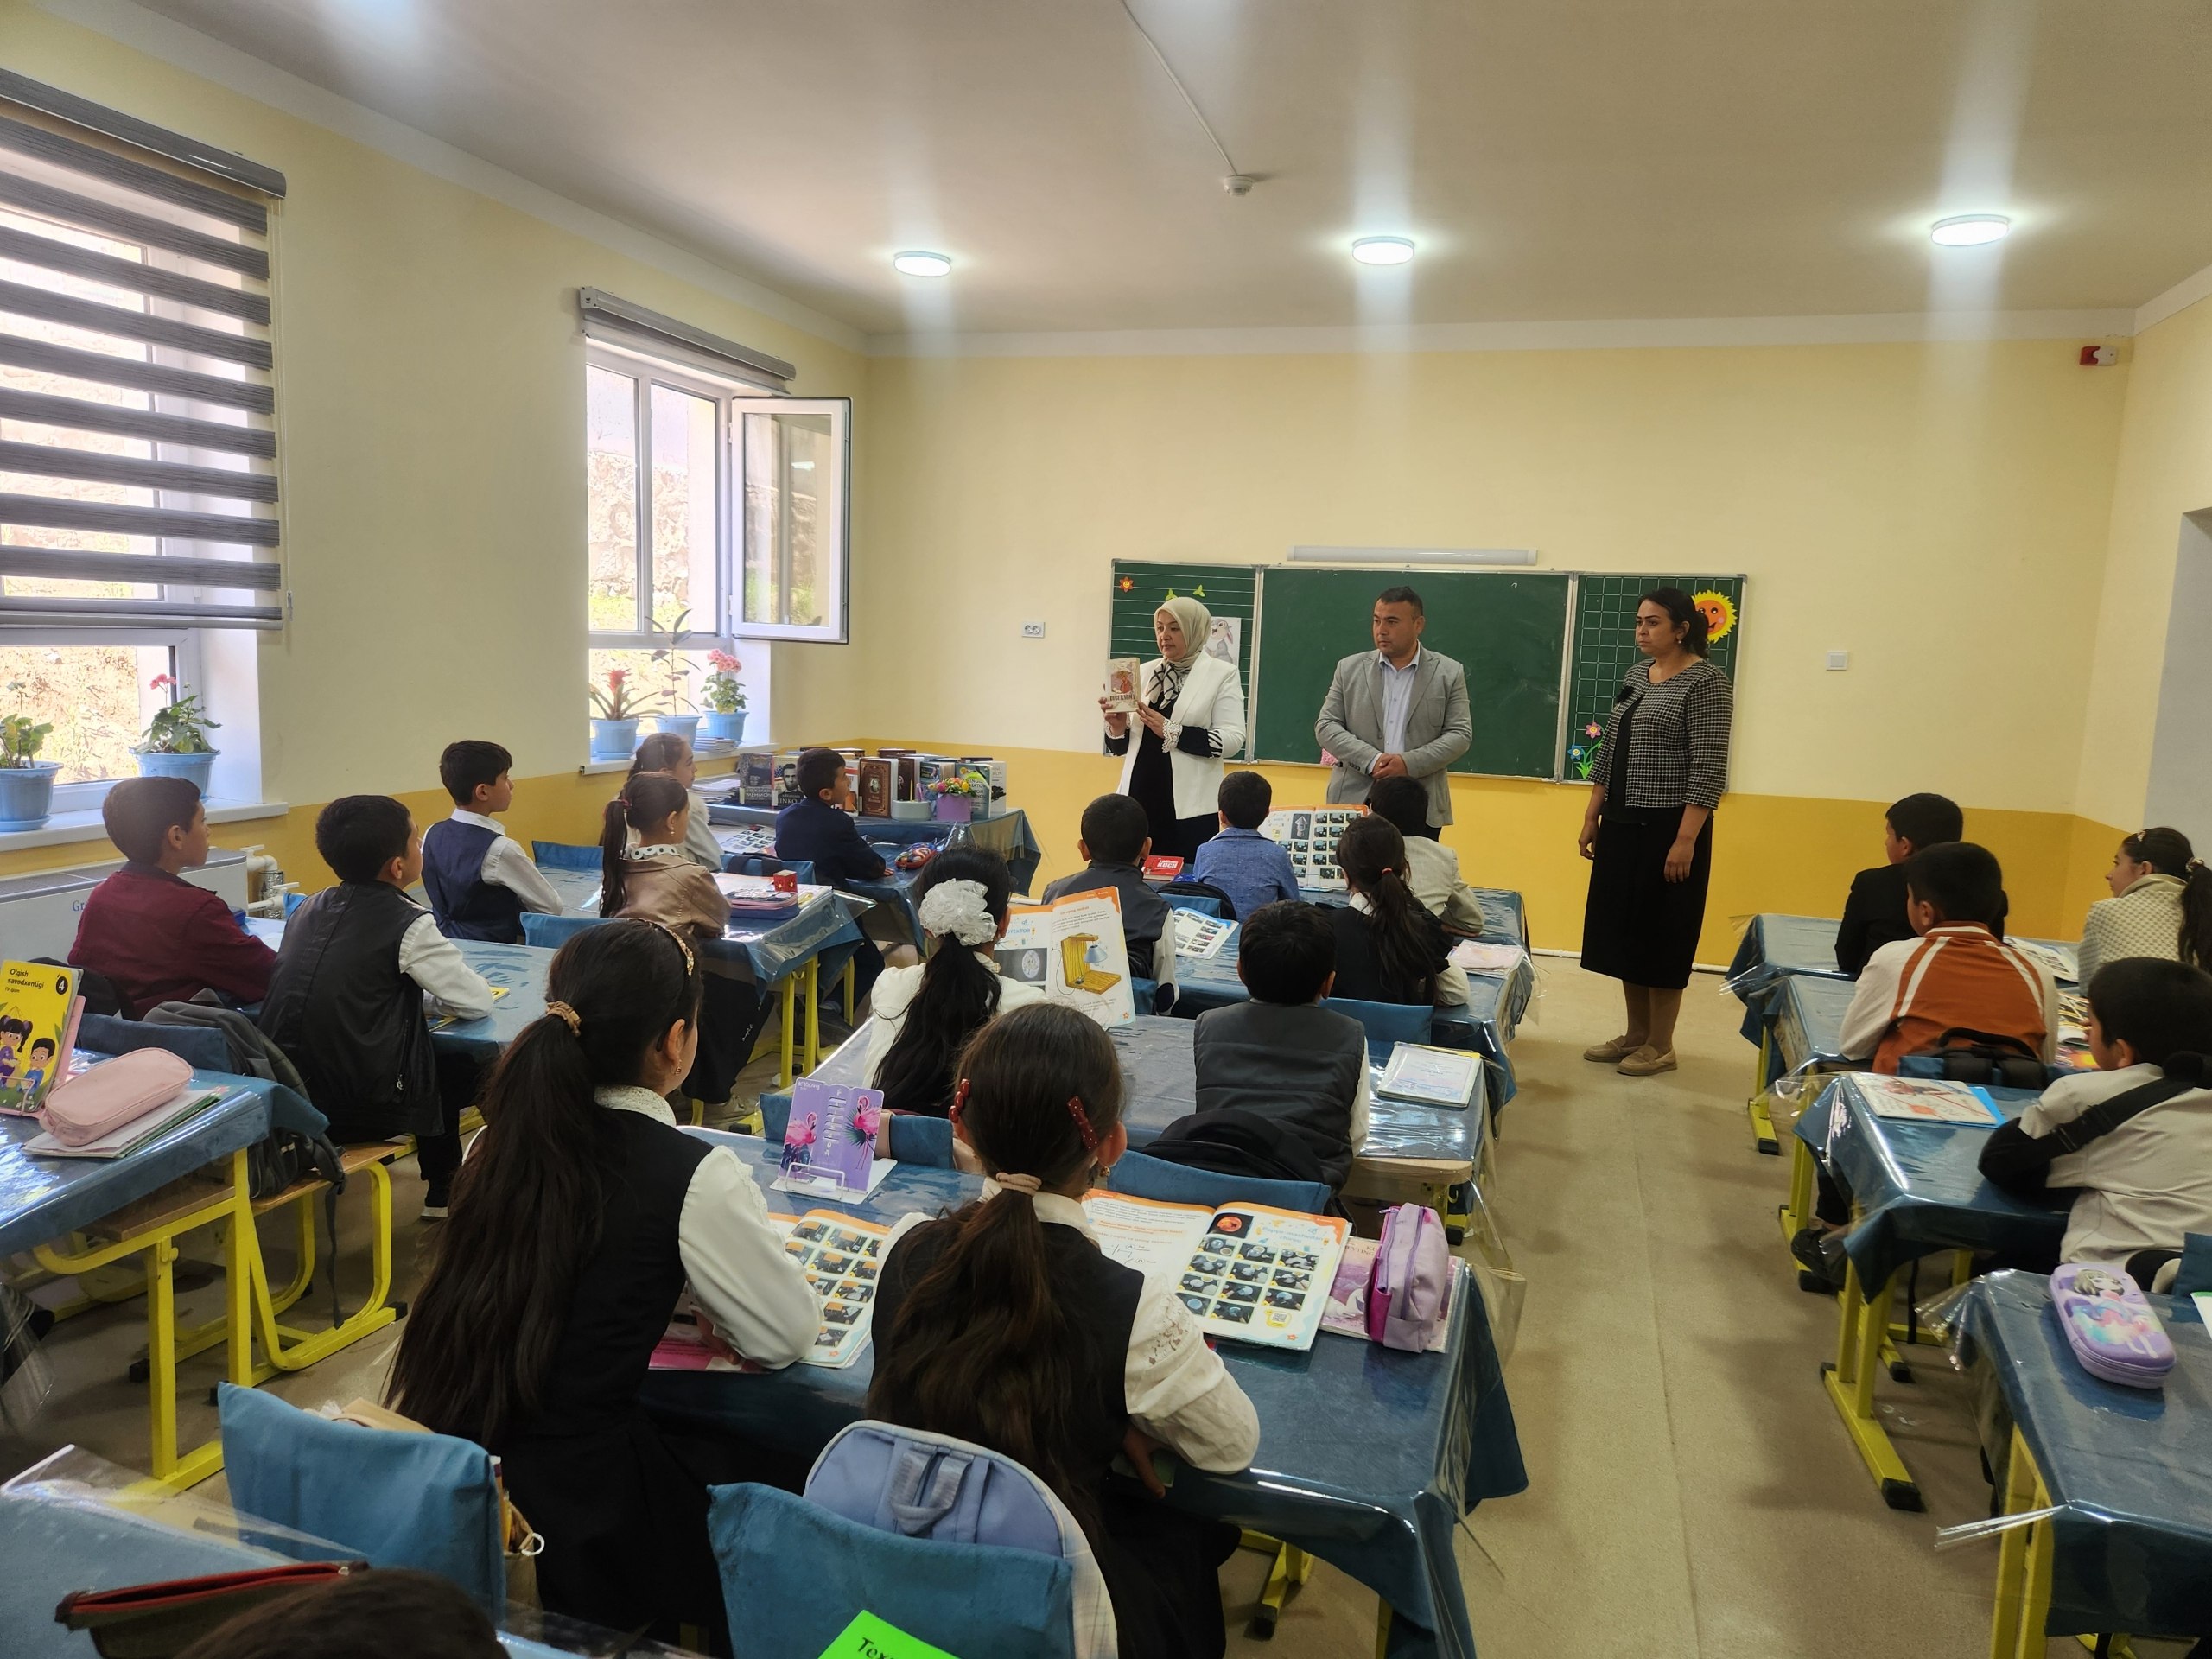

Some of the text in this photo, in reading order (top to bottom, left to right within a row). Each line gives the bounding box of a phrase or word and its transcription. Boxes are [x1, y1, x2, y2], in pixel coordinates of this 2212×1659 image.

[10, 968, 29, 977] O'qish
[7, 978, 44, 989] savodxonligi
[58, 980, 65, 991] 4
